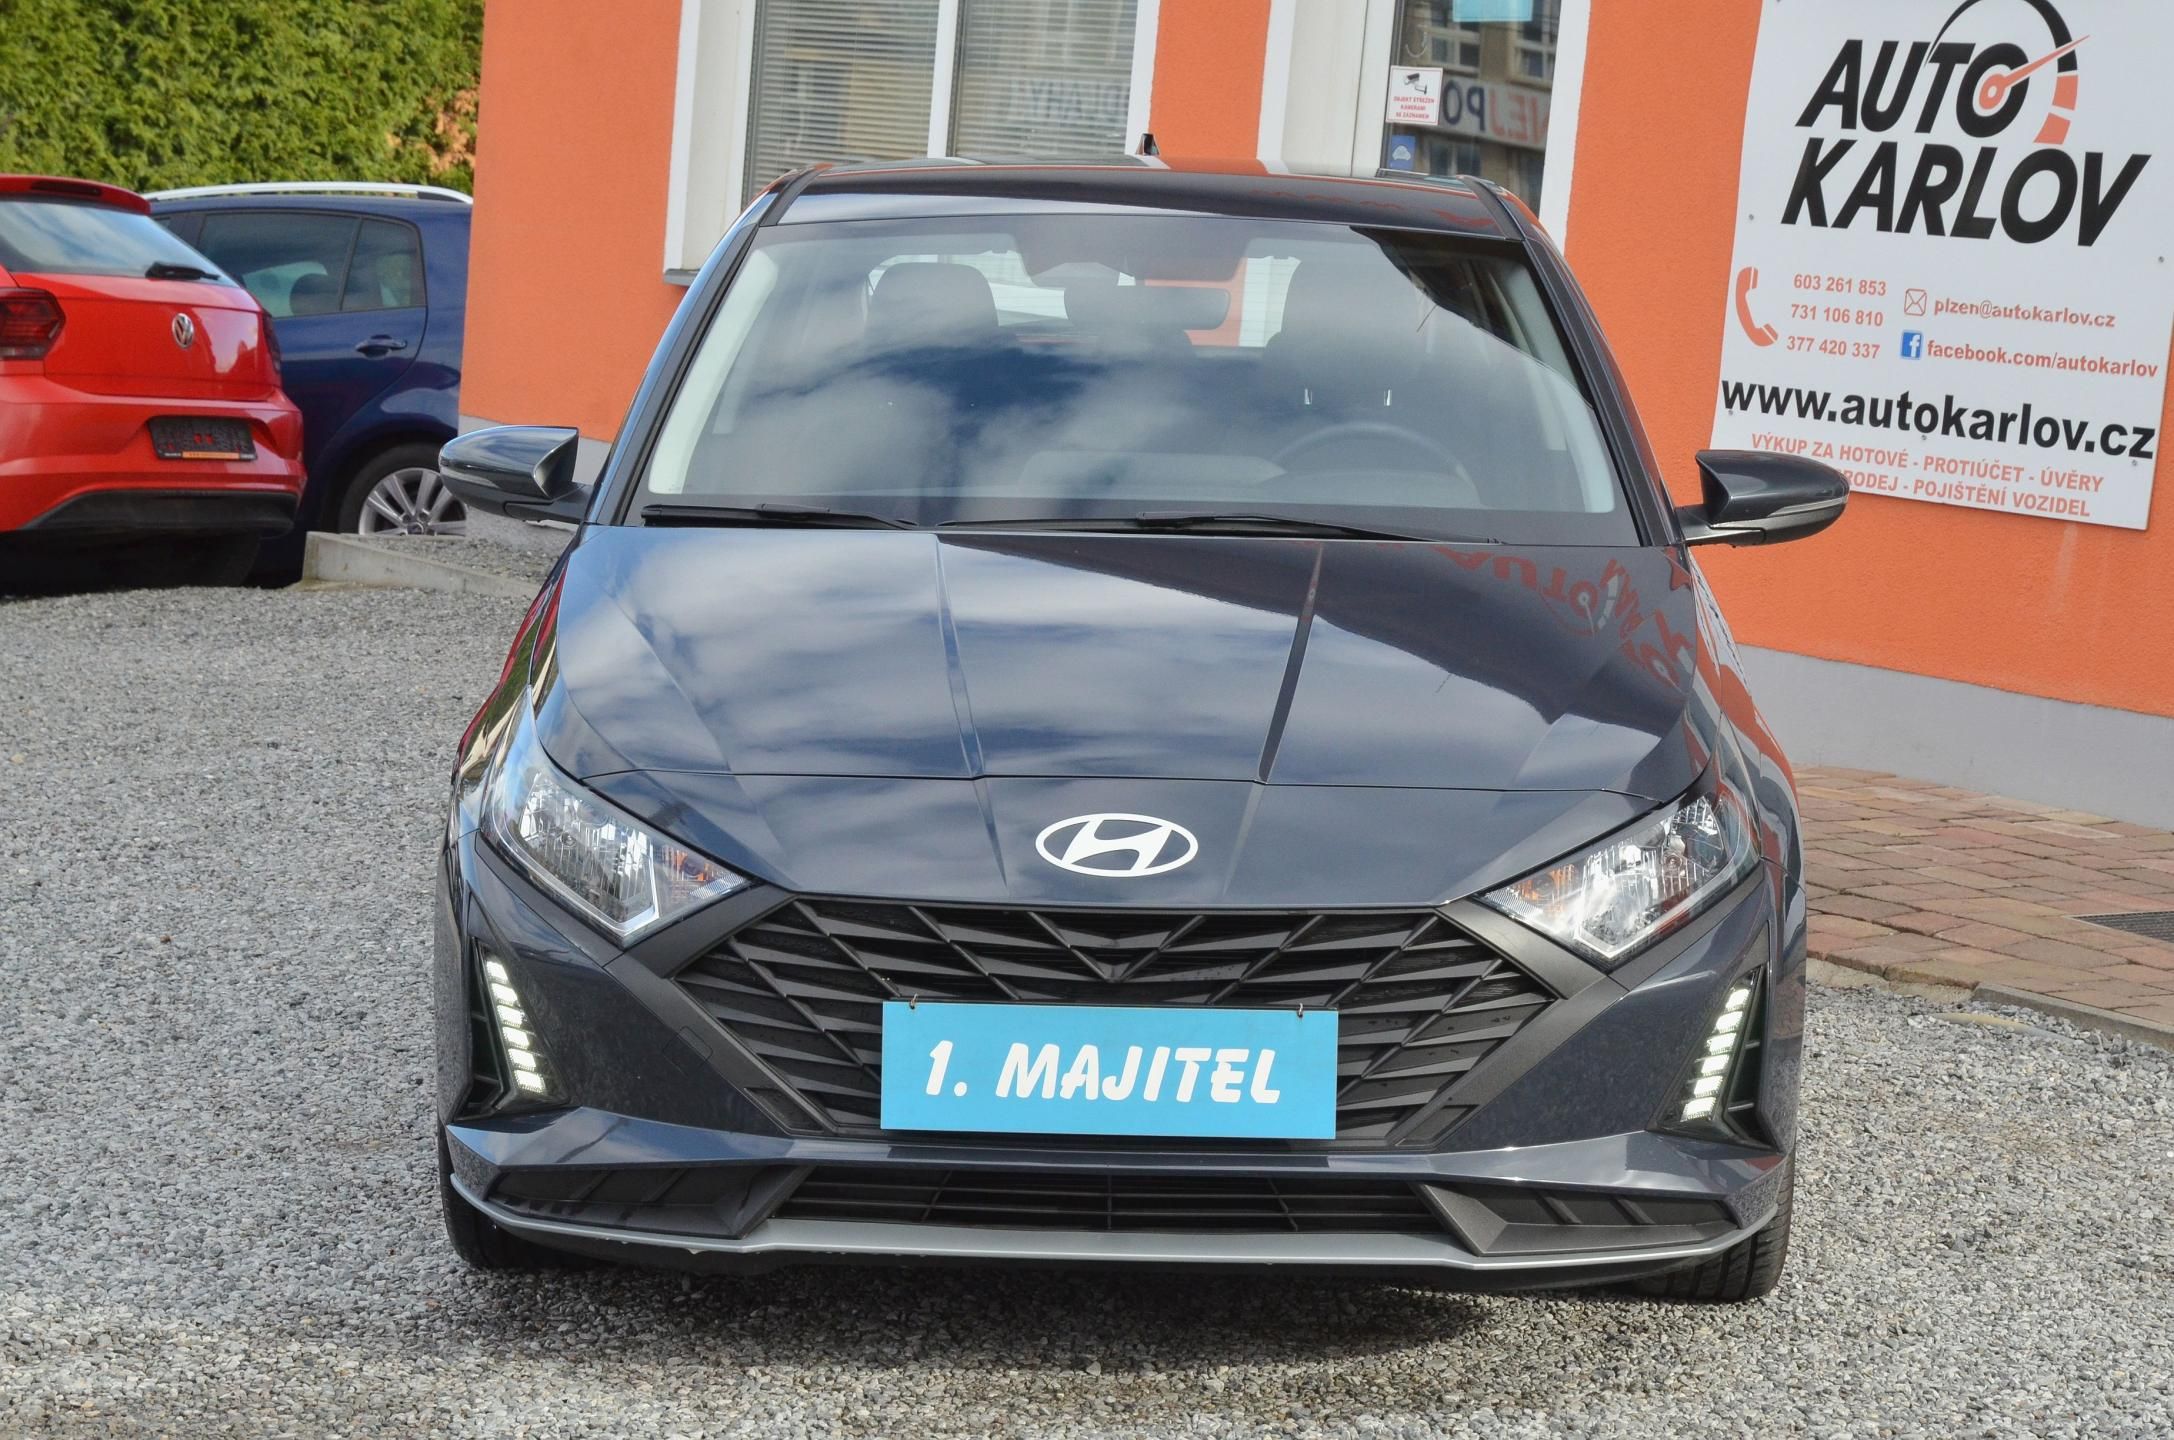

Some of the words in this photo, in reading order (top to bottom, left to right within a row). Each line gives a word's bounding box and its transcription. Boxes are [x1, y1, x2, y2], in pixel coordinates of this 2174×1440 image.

[1795, 39, 2030, 138] AUTO
[1781, 137, 2152, 247] KARLOV
[1793, 273, 1821, 290] 603
[1825, 276, 1853, 293] 261
[1857, 279, 1886, 297] 853
[1791, 303, 1817, 320] 731
[1823, 306, 1851, 324] 106
[1855, 310, 1884, 327] 810
[1934, 298, 2116, 329] plzen@autokarlov.cz
[1786, 335, 1815, 352] 377
[1819, 338, 1847, 356] 420
[1851, 342, 1881, 359] 337
[1926, 340, 2160, 379] facebook.com/autokarlov
[1721, 379, 2156, 460] www.autokarlov.cz
[1751, 432, 1808, 455] VÝKUP
[1811, 440, 1835, 459] ZA
[1838, 444, 1909, 471] HOTOVÉ
[1923, 454, 2025, 483] PROTIÚČET
[2039, 466, 2105, 493] ÚVĚRY
[1838, 469, 1900, 492] RODEJ
[1912, 478, 2008, 507] POJIŠTĚNÍ
[2012, 490, 2091, 518] VOZIDEL
[926, 1039, 968, 1097] 1.
[994, 1042, 1281, 1104] MAJITEL
